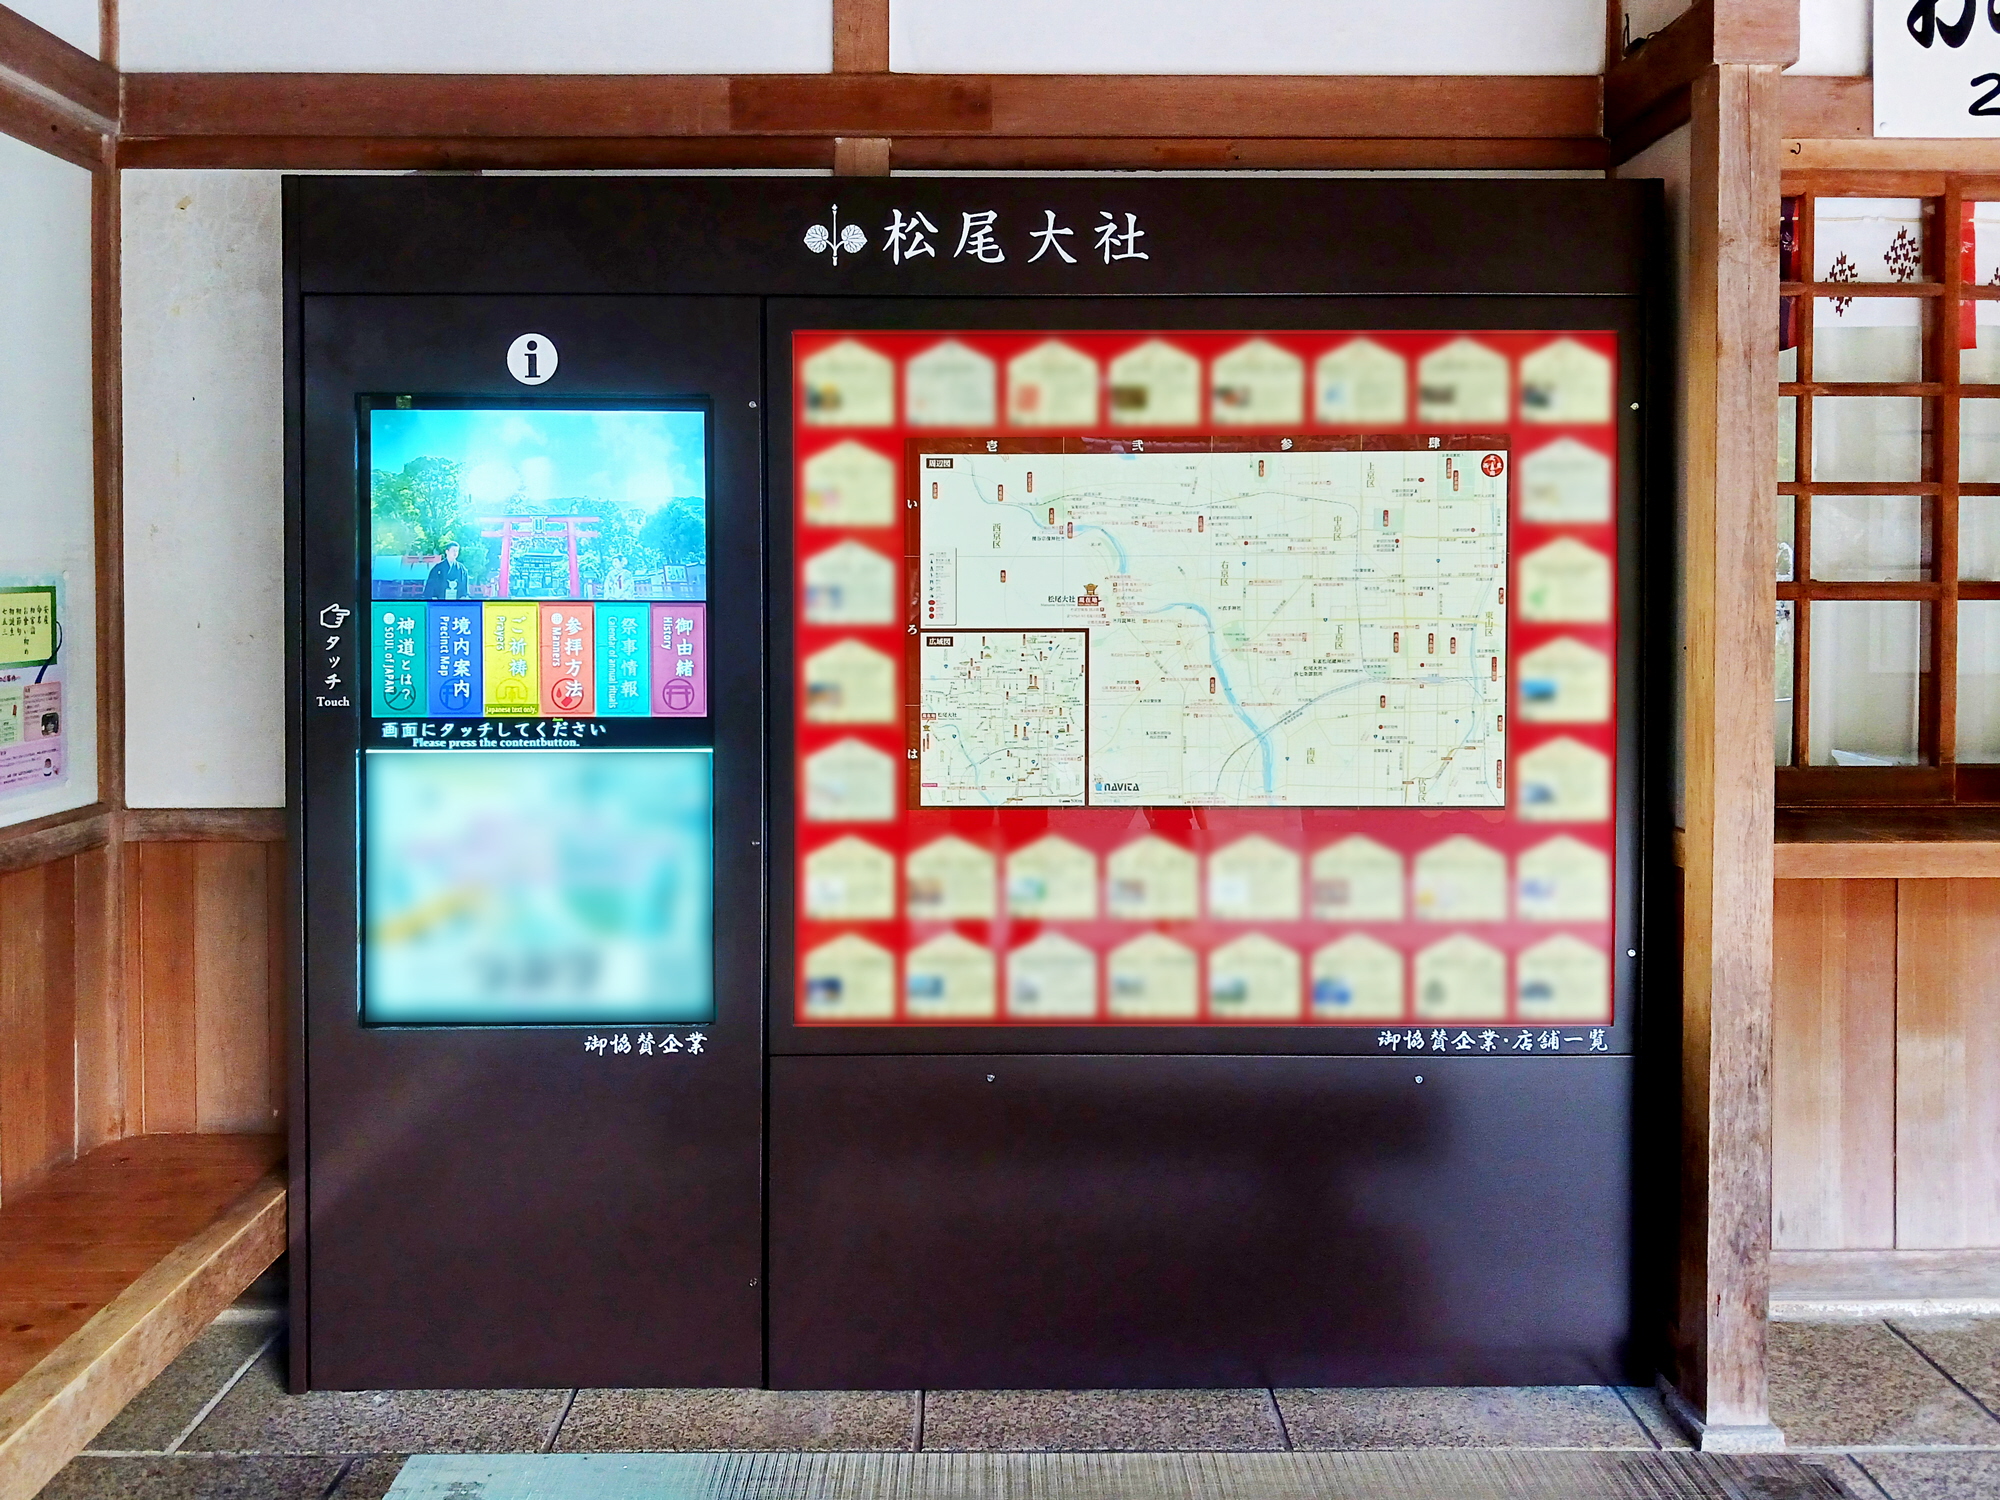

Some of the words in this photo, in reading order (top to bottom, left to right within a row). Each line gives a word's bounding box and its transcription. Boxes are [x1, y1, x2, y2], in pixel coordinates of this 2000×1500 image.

[882, 208, 1150, 266] 松尾大社
[907, 499, 918, 509] い
[1047, 595, 1076, 603] 松尾大社
[384, 626, 395, 651] SOUL
[439, 616, 451, 654] Precinct
[493, 616, 507, 651] Prayers
[607, 616, 618, 649] Calendar
[660, 616, 673, 650] History
[907, 624, 918, 635] ろ
[384, 652, 395, 663] of
[396, 616, 415, 701] 神道とは？
[451, 616, 472, 698] 境内案内
[508, 616, 528, 677] ご祈祷
[551, 626, 562, 667] Manners
[564, 616, 584, 698] 参拝方法
[620, 617, 640, 698] 祭事情報
[674, 617, 695, 677] 御由緒
[325, 635, 342, 690] タッチ
[437, 655, 451, 677] Map
[607, 658, 618, 684] annual
[383, 664, 395, 693] JAPAN
[316, 696, 350, 707] Touch
[607, 685, 618, 709] rituals
[381, 721, 607, 739] 画面にタッチしてください
[412, 737, 447, 748] Please
[448, 739, 478, 749] press
[479, 737, 497, 747] the
[499, 737, 581, 748] contentbutton.
[907, 748, 918, 760] は
[583, 1031, 708, 1057] 御協賛企業
[1377, 1028, 1609, 1053] 御協賛企業・店舗一覧
